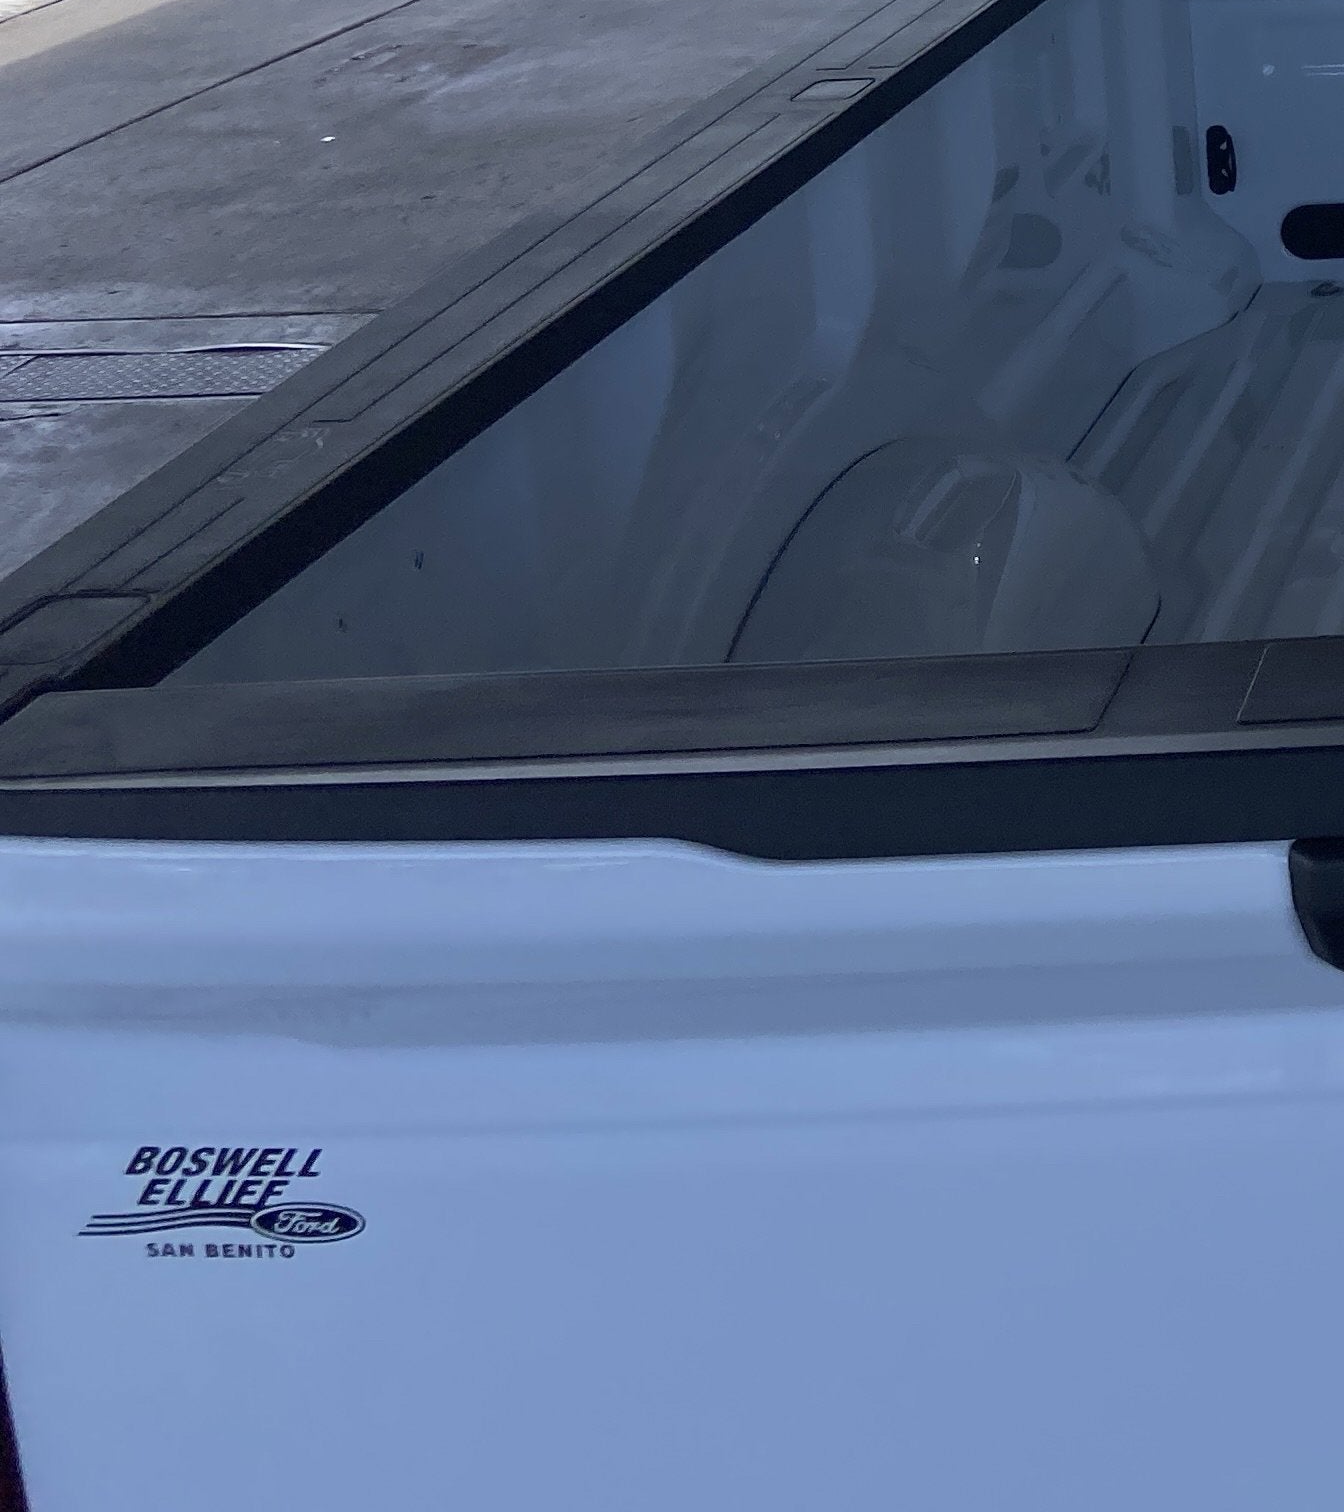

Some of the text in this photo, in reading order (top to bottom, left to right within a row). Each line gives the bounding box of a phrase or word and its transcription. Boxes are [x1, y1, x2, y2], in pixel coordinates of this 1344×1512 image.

[124, 1146, 323, 1177] BOSWELL
[137, 1178, 290, 1207] ELLIEF
[273, 1210, 341, 1234] Ford
[146, 1243, 296, 1258] SAN BENITO
